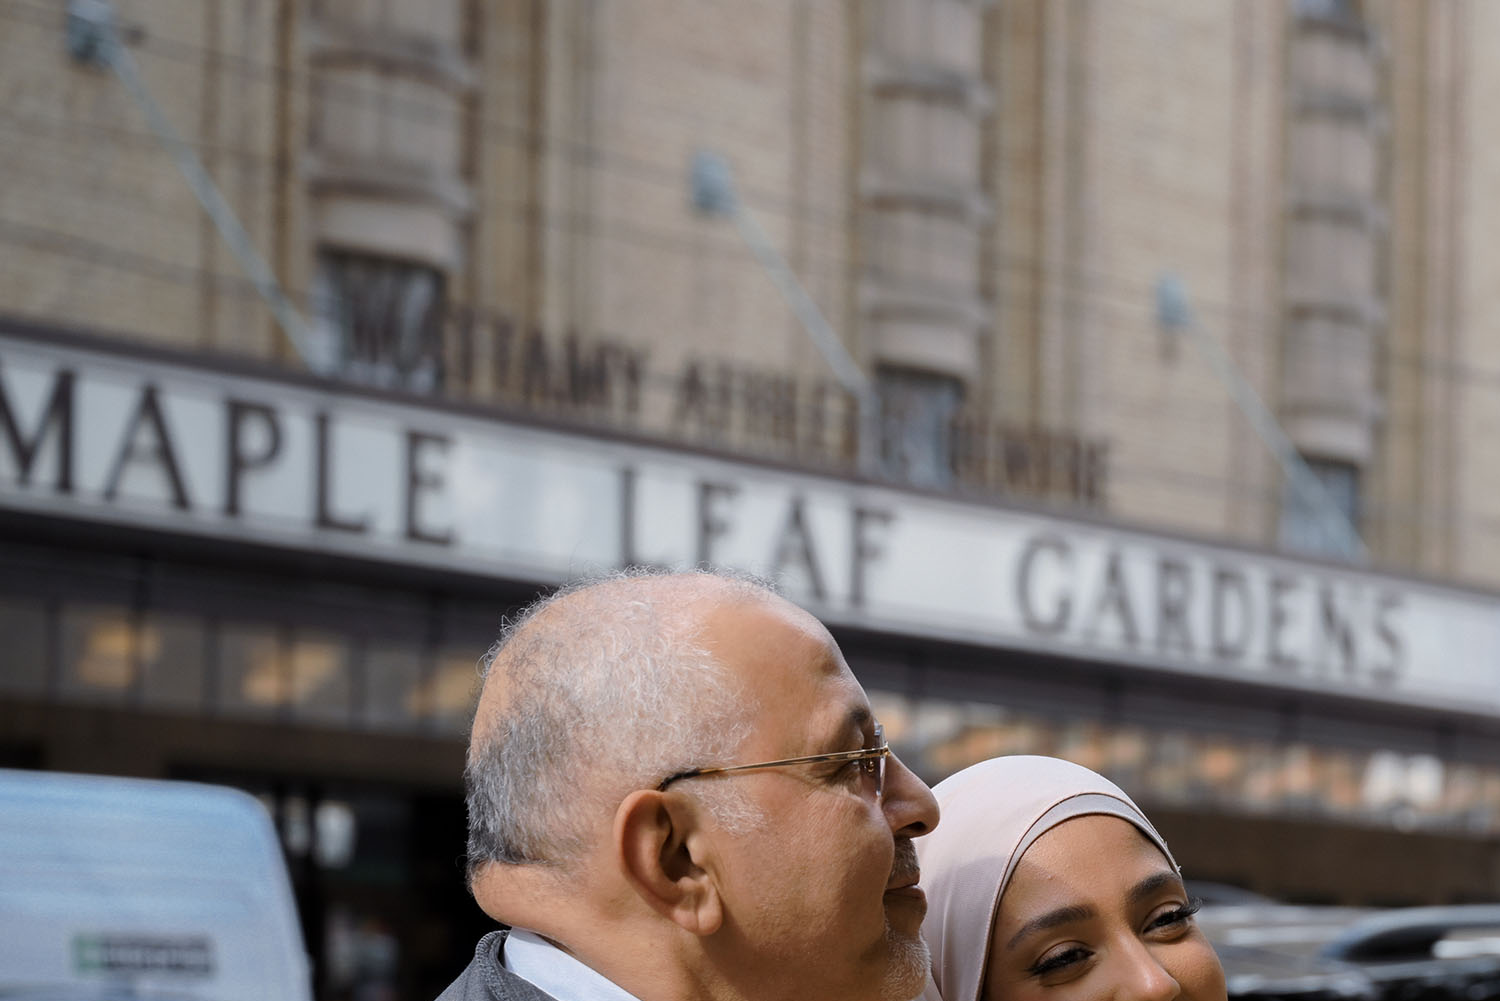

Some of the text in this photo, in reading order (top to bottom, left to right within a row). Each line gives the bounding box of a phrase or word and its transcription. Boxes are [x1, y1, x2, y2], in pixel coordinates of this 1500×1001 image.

[0, 367, 1410, 681] MAPLE LEAF GARDENS
